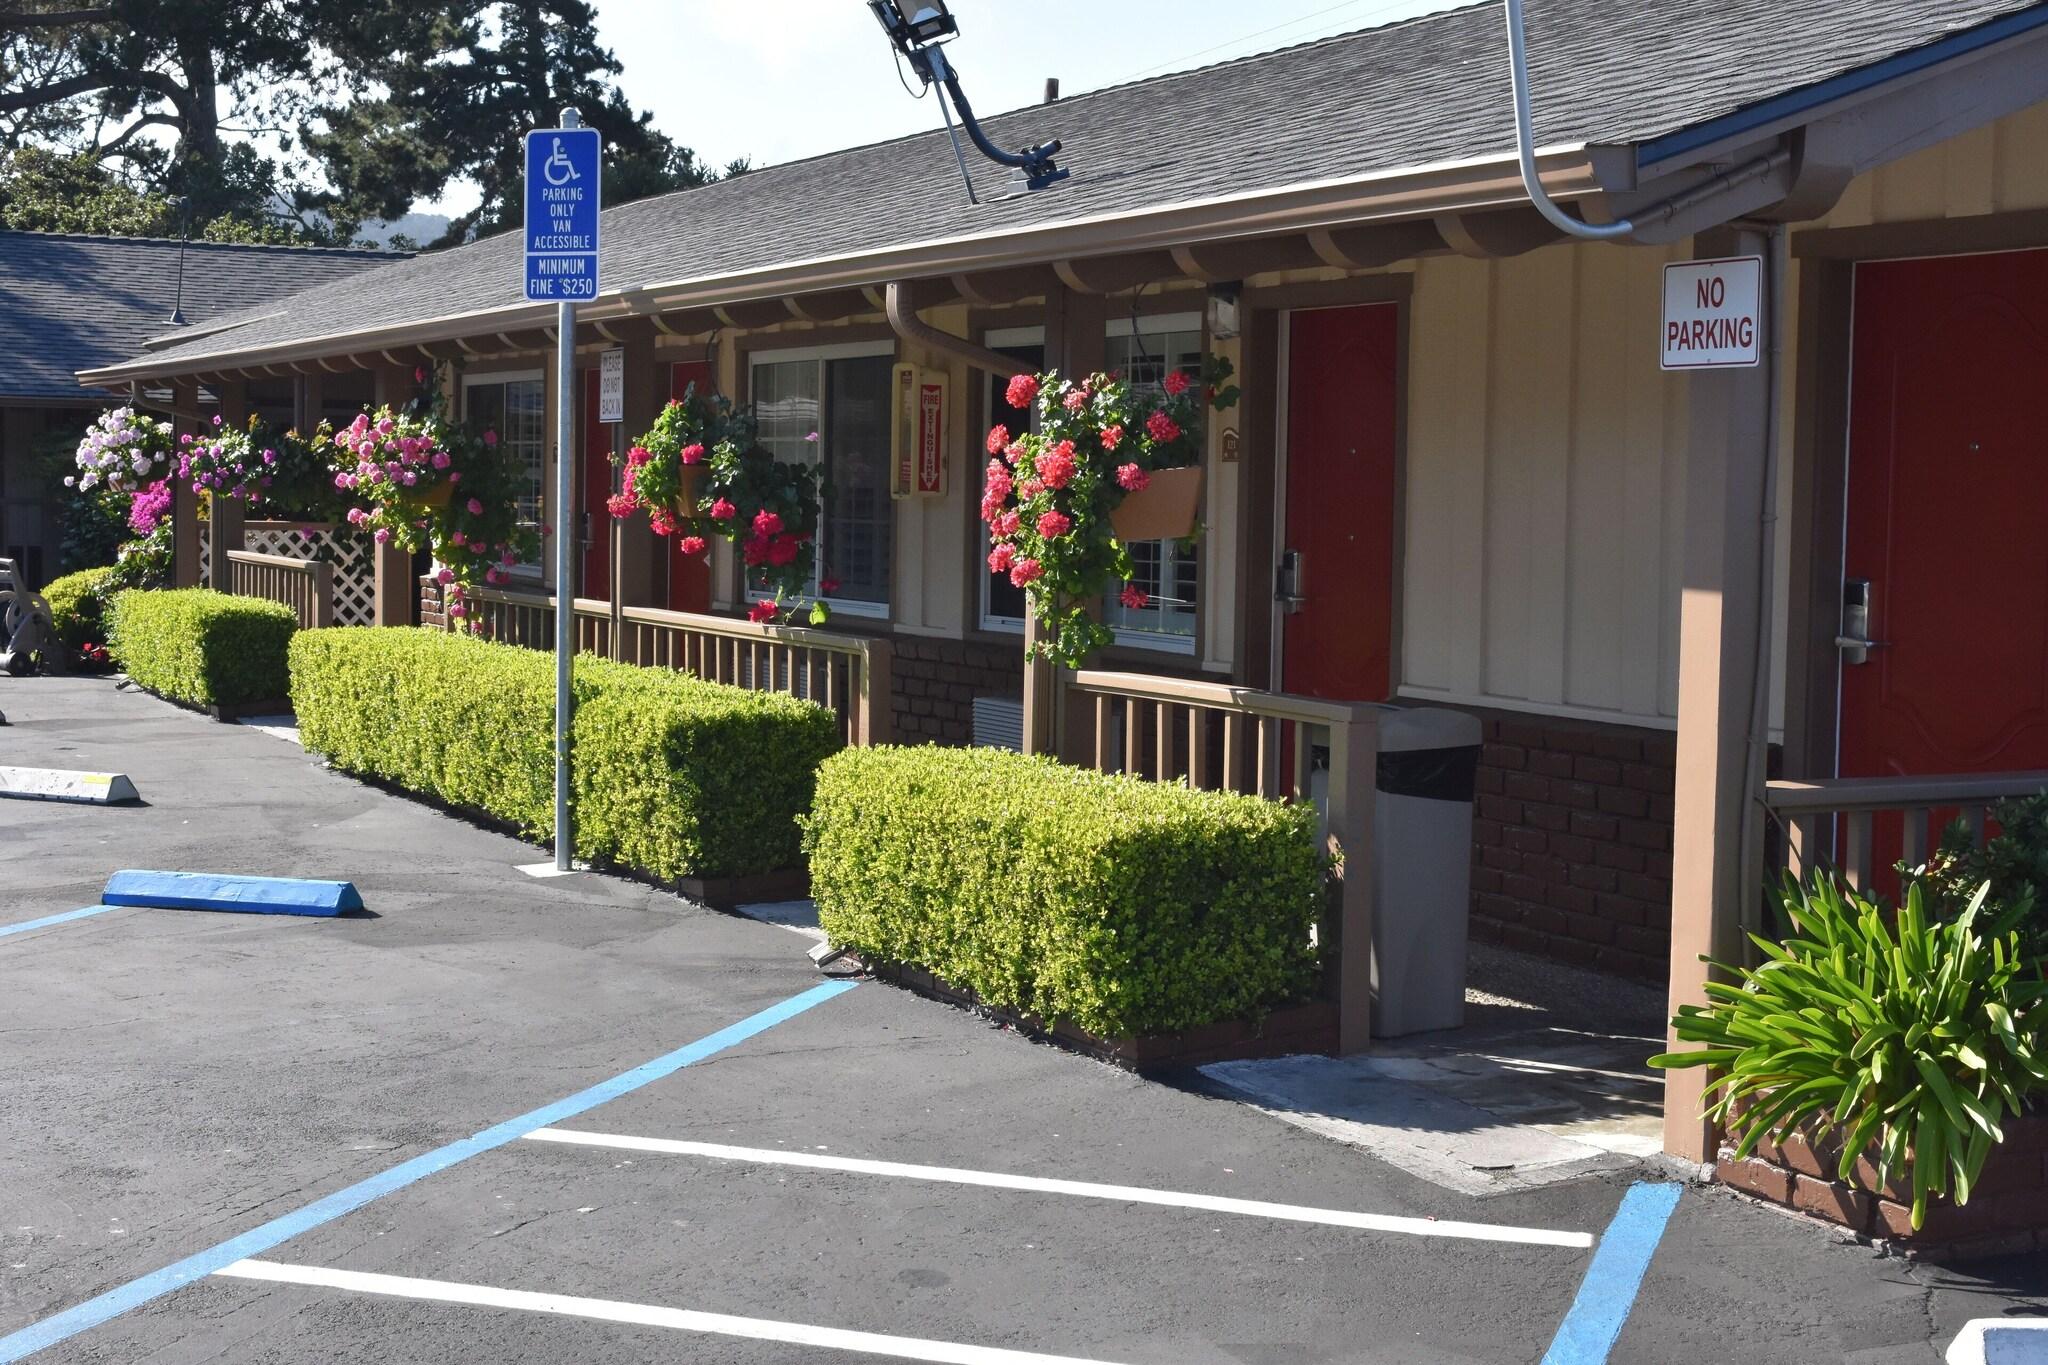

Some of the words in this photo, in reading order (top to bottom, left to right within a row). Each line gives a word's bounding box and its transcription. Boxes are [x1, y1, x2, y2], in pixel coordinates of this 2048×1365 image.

[543, 187, 583, 201] PARKING
[550, 204, 575, 217] ONLY
[553, 220, 571, 233] VAN
[534, 235, 590, 249] ACCESSIBLE
[539, 259, 585, 275] MINIMUM
[530, 279, 553, 295] FINE
[562, 278, 593, 296] $250
[1697, 277, 1725, 309] NO
[1667, 316, 1753, 351] PARKING
[603, 353, 621, 372] PLEASE
[603, 376, 610, 393] DO
[610, 375, 620, 393] NOT
[602, 397, 615, 415] BACK
[615, 397, 621, 414] IN
[923, 394, 939, 405] FIRE
[926, 408, 935, 483] EXTINGUISHER
